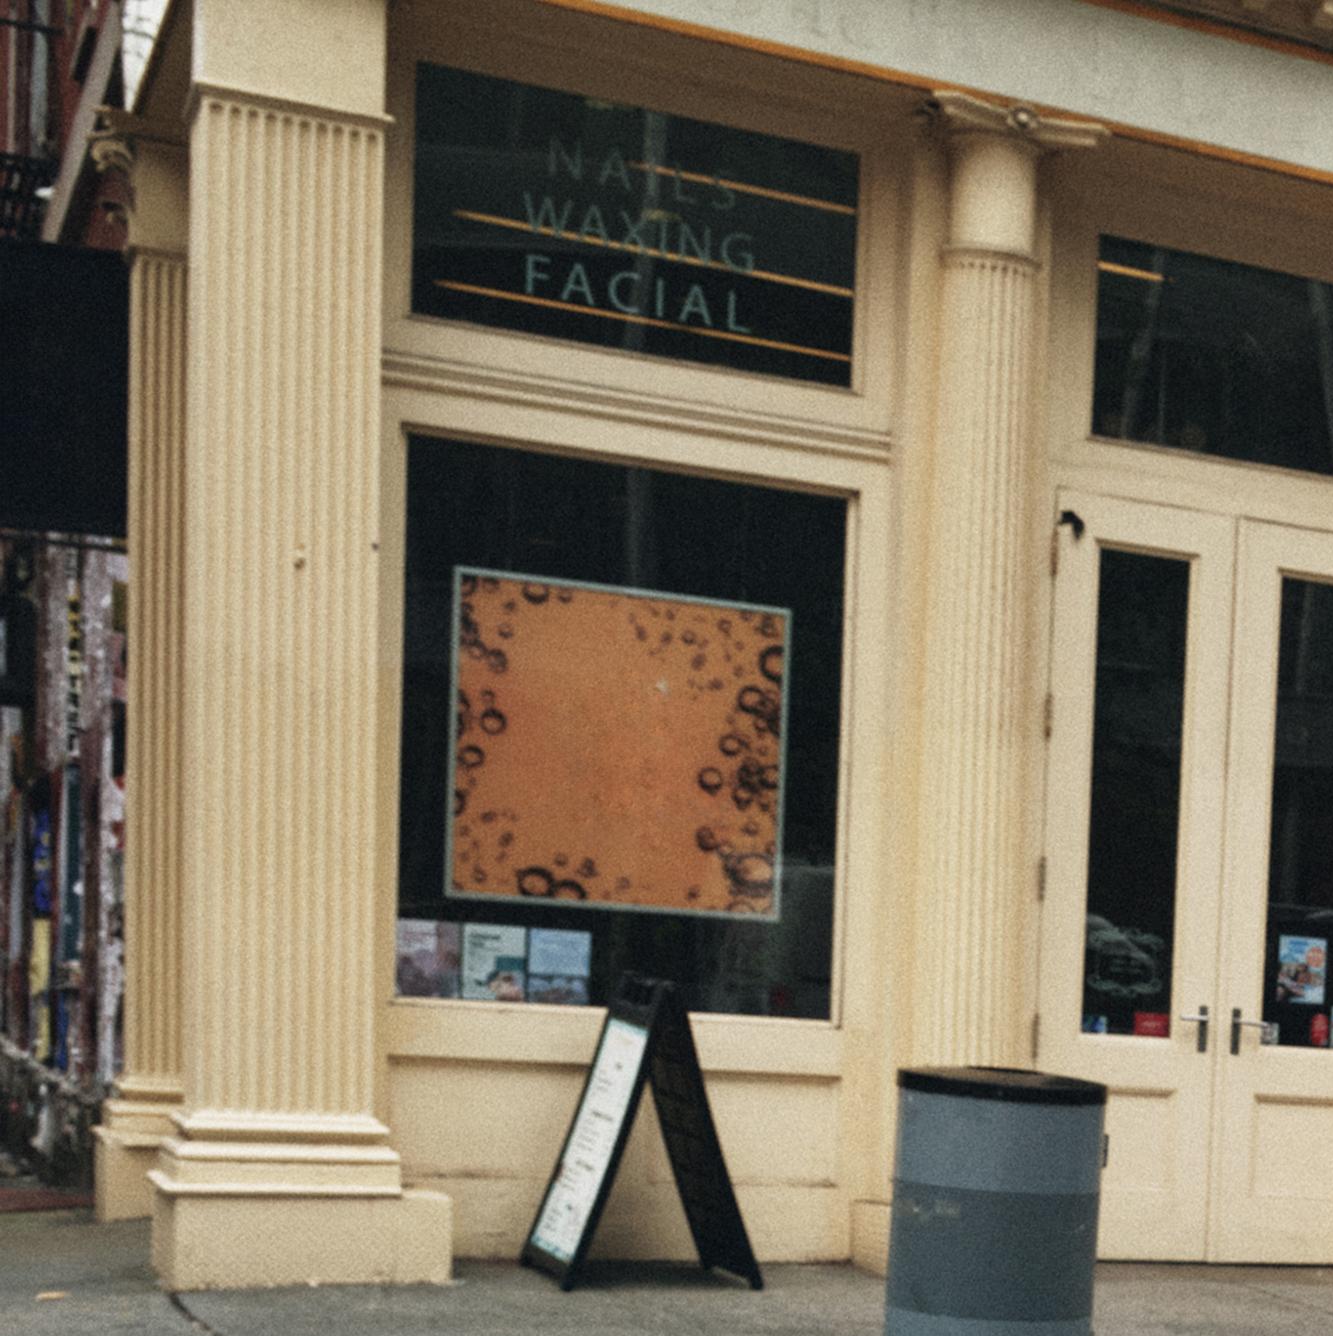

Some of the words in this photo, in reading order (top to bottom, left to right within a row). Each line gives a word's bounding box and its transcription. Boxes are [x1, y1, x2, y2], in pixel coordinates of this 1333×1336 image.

[549, 139, 737, 211] NAILS
[523, 190, 755, 275] WAXING
[525, 253, 751, 333] FACIAL
